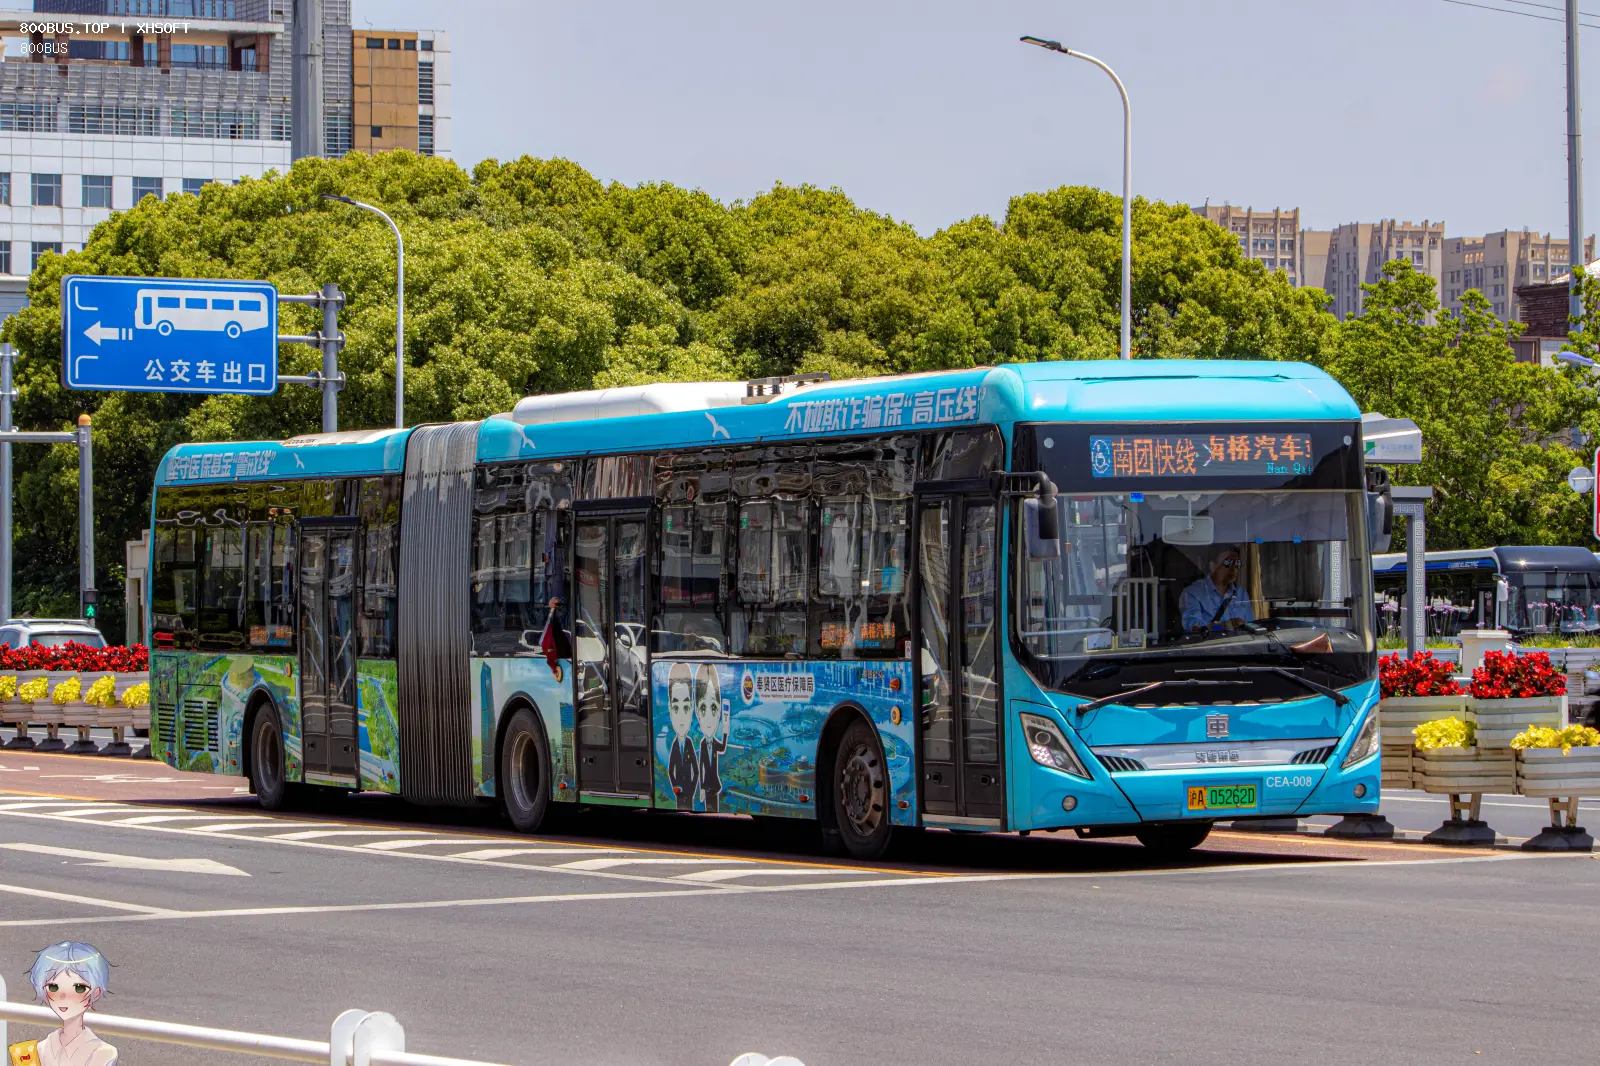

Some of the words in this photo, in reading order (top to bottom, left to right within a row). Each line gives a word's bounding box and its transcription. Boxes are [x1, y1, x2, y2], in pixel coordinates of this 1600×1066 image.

[143, 358, 266, 384] 公交车出口
[1111, 437, 1197, 476] 南团快线
[756, 676, 814, 693] 奉贤区医疗保障局
[1265, 775, 1313, 788] CEA-008
